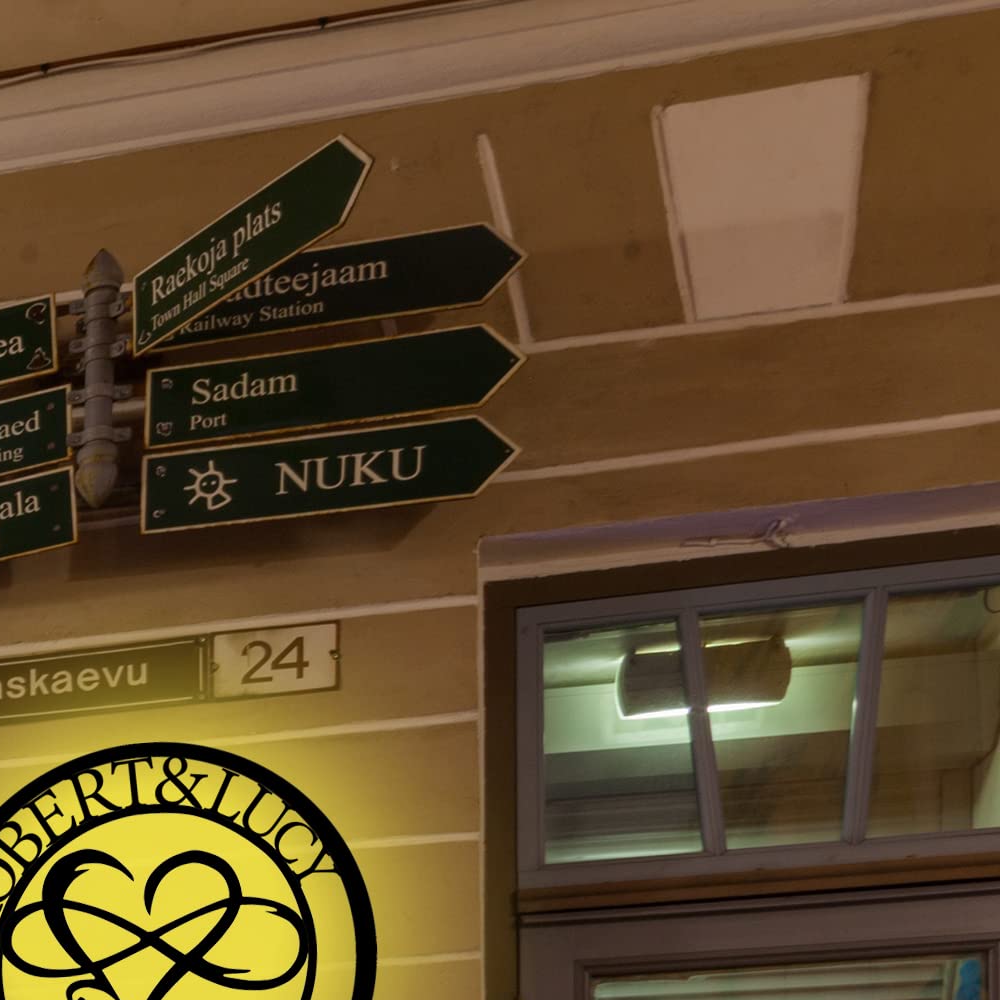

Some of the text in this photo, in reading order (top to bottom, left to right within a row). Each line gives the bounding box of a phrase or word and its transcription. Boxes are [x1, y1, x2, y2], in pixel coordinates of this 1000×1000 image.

[152, 202, 282, 306] Raekoja plats
[151, 258, 249, 331] Town Hall Square
[259, 301, 325, 322] Station
[191, 372, 298, 405] Sadam
[190, 413, 228, 431] Port
[274, 444, 428, 495] NUKU
[240, 635, 310, 684] 24
